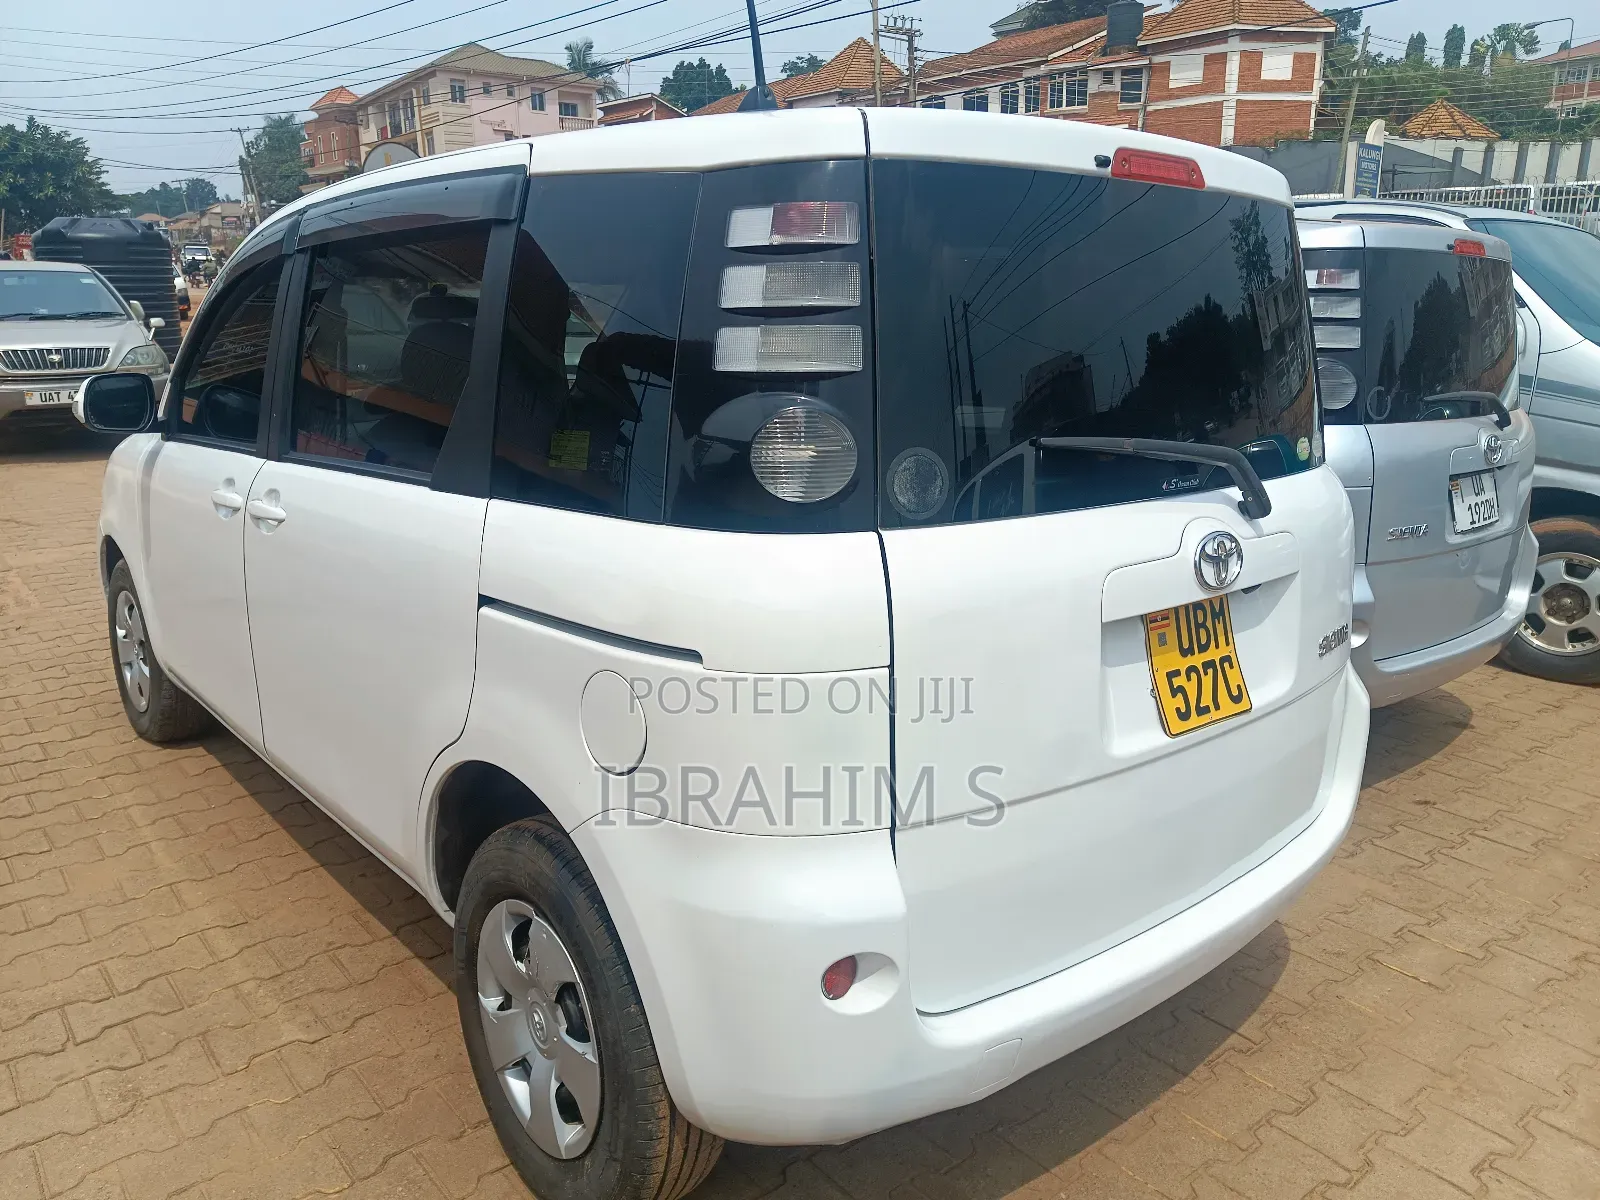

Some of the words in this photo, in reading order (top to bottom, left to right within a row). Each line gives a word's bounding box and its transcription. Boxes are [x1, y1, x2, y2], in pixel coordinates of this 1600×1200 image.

[39, 391, 61, 403] UAT
[67, 390, 79, 402] 4
[1470, 473, 1486, 497] UA
[1173, 597, 1231, 659] UBM
[1165, 653, 1244, 722] 527C
